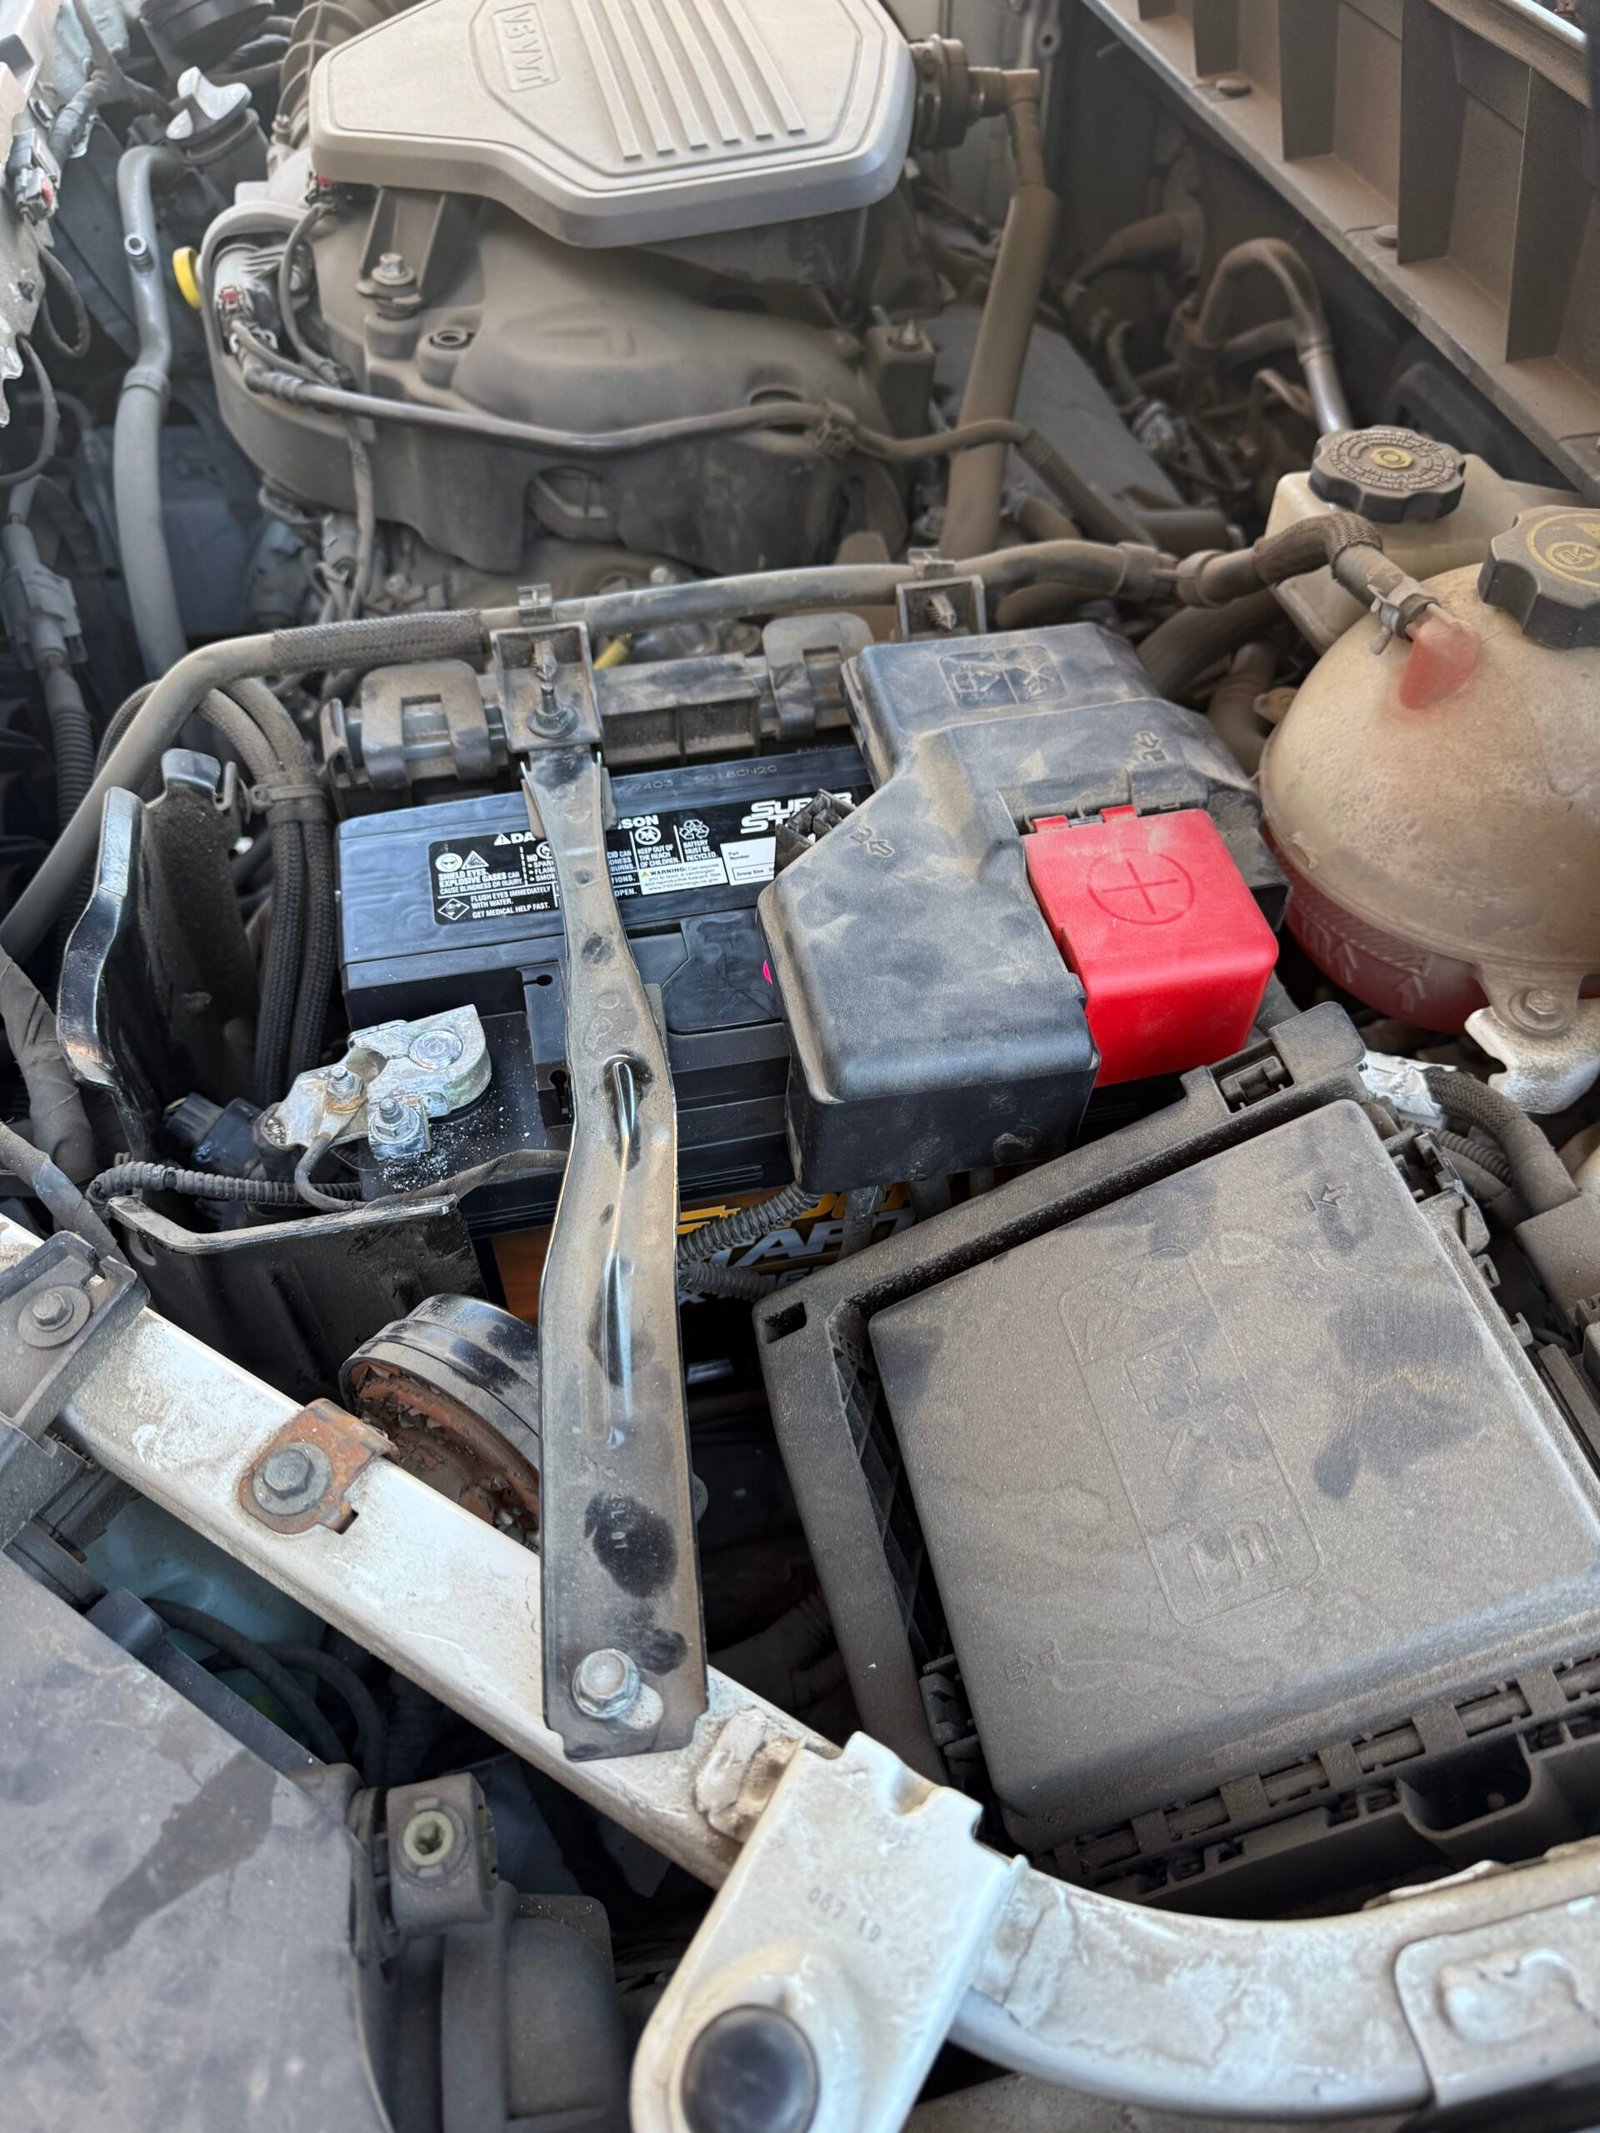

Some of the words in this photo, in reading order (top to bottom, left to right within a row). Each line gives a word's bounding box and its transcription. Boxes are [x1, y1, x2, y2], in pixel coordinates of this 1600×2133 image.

[618, 814, 660, 830] SON
[683, 839, 709, 849] BATTERY
[607, 850, 618, 859] CID
[620, 849, 631, 857] CAN
[637, 846, 652, 855] KEEP
[652, 845, 664, 853] OUT
[684, 846, 701, 855] MUST
[639, 853, 650, 861] THE
[651, 852, 671, 860] REACH
[686, 851, 719, 861] RECYCLED.
[534, 860, 554, 868] SPAR
[640, 860, 649, 868] OF
[649, 857, 680, 867] CHILDREN.
[535, 867, 556, 875] FLAM
[610, 864, 636, 873] BURNS.
[650, 867, 687, 877] WARNING:
[438, 871, 465, 880] SHIELD
[440, 877, 481, 887] EXPLOSIVE
[482, 872, 507, 882] GASES
[460, 883, 491, 892] BLINDNESS
[502, 879, 523, 887] INJURY.
[471, 894, 491, 902] FLUSH
[510, 886, 551, 897] IMMEDIATELY
[614, 887, 638, 897] OPEN.
[490, 899, 514, 907] WATER.
[473, 910, 485, 918] GET
[486, 907, 514, 917] MEDICAL
[515, 905, 532, 913] HELP
[533, 902, 550, 910] FAST.
